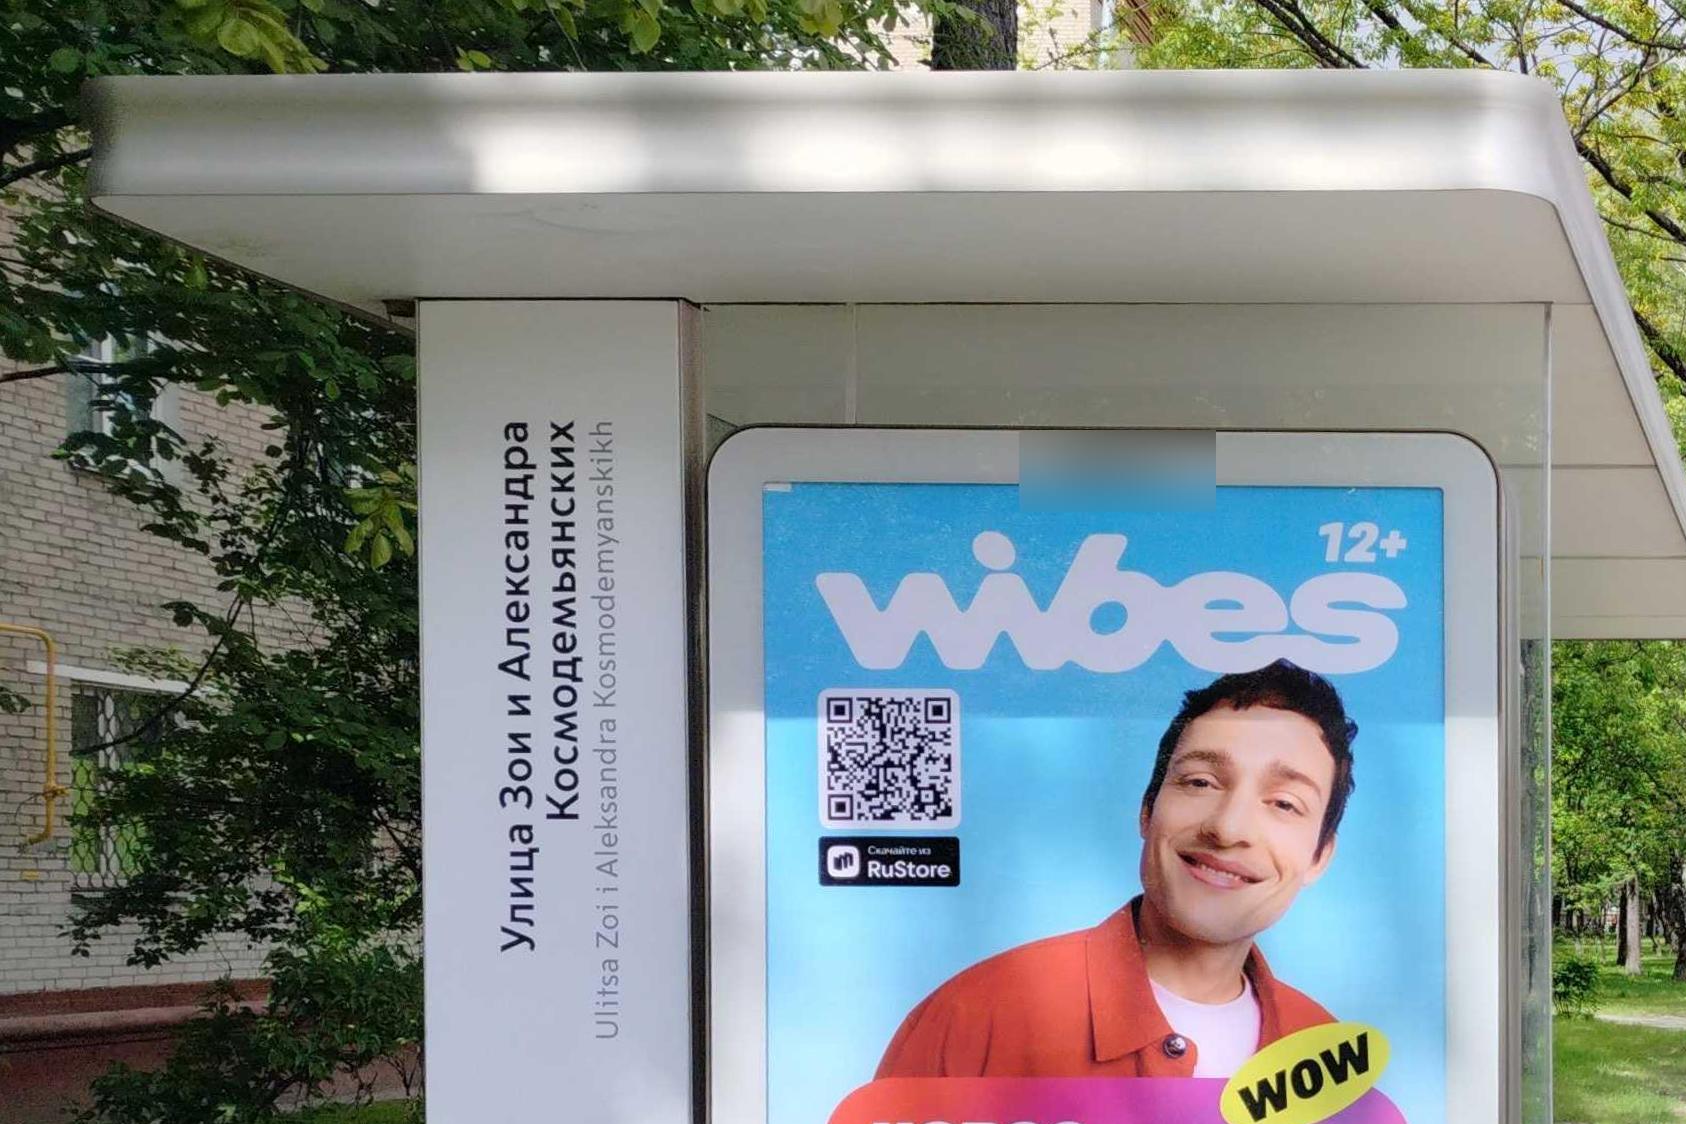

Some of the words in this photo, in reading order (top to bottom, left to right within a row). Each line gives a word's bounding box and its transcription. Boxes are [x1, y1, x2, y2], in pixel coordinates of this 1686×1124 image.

[498, 421, 537, 682] Александра
[588, 421, 620, 708] Kosmodemyanskikh
[1318, 520, 1408, 564] 12+
[546, 420, 584, 820] Космодемьянских
[815, 530, 1408, 675] wibes
[507, 693, 532, 717] и
[499, 731, 534, 810] Зои
[593, 717, 619, 878] Aleksandra
[500, 823, 540, 953] Улица
[596, 886, 619, 895] i
[867, 845, 917, 856] Скачайте
[919, 847, 932, 856] из
[867, 860, 952, 879] RuStore
[595, 904, 619, 949] Zoi
[594, 958, 619, 1039] Ulitsa
[1237, 1030, 1371, 1122] WOW
